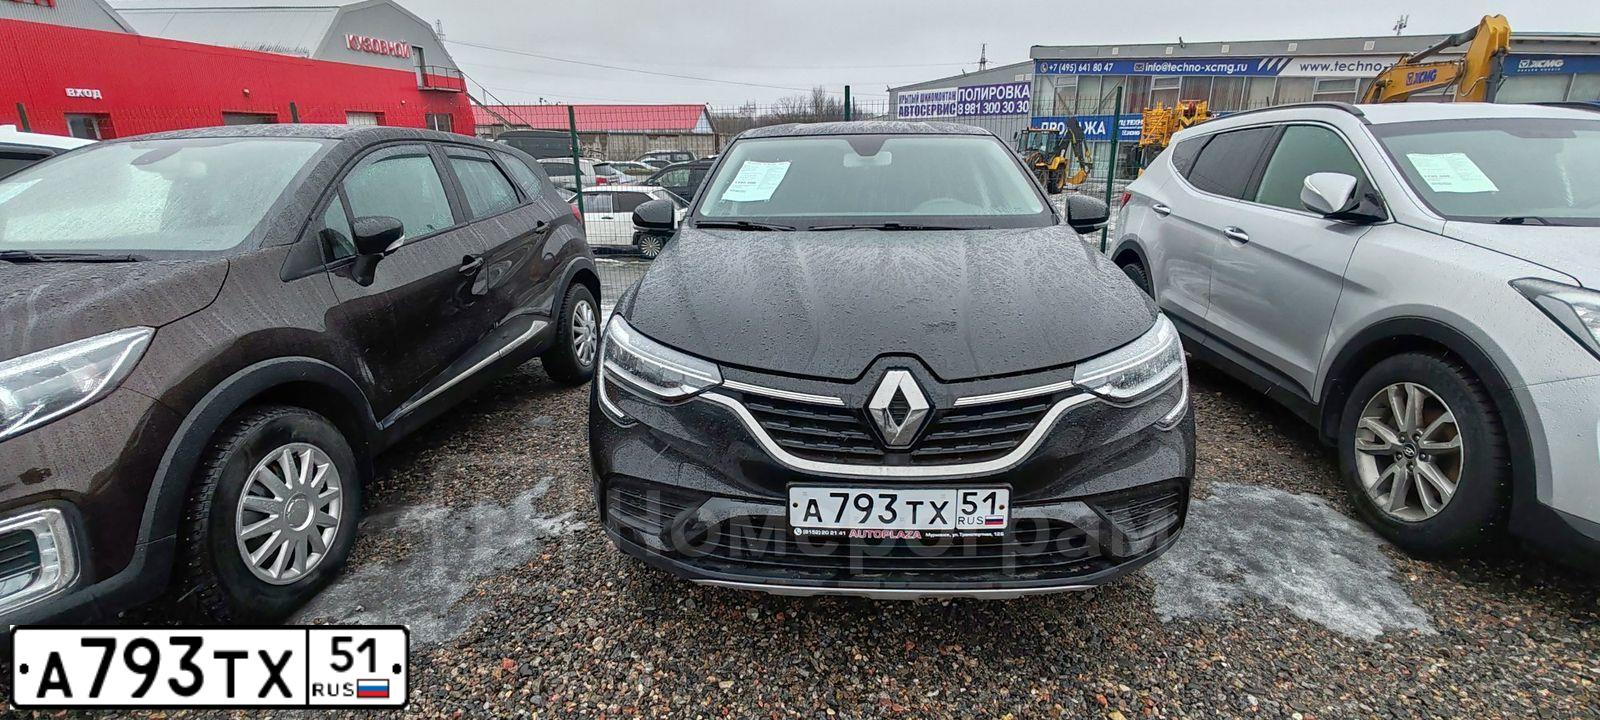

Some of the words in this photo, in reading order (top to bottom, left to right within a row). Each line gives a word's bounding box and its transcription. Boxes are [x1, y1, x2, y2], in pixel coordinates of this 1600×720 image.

[345, 33, 410, 57] КУЗОВНОЙ
[1049, 63, 1058, 71] +7
[1059, 62, 1077, 73] (495)
[1079, 63, 1091, 71] 641
[1093, 63, 1102, 71] 80
[1104, 62, 1114, 71] 47
[1145, 61, 1248, 74] info@techno-xcmg.ru
[65, 87, 103, 100] ВХОД
[958, 84, 1030, 102] ПОЛИРОВКА
[899, 103, 956, 117] АВТОСЕРВИС
[958, 104, 965, 115] 8
[966, 103, 981, 115] 981
[983, 102, 1001, 114] 300
[1002, 101, 1016, 113] 30
[1017, 100, 1030, 113] 30
[803, 492, 949, 525] А793ТХ
[961, 491, 997, 516] 51
[958, 516, 984, 525] RUS
[848, 529, 923, 540] AUTOPLAZA
